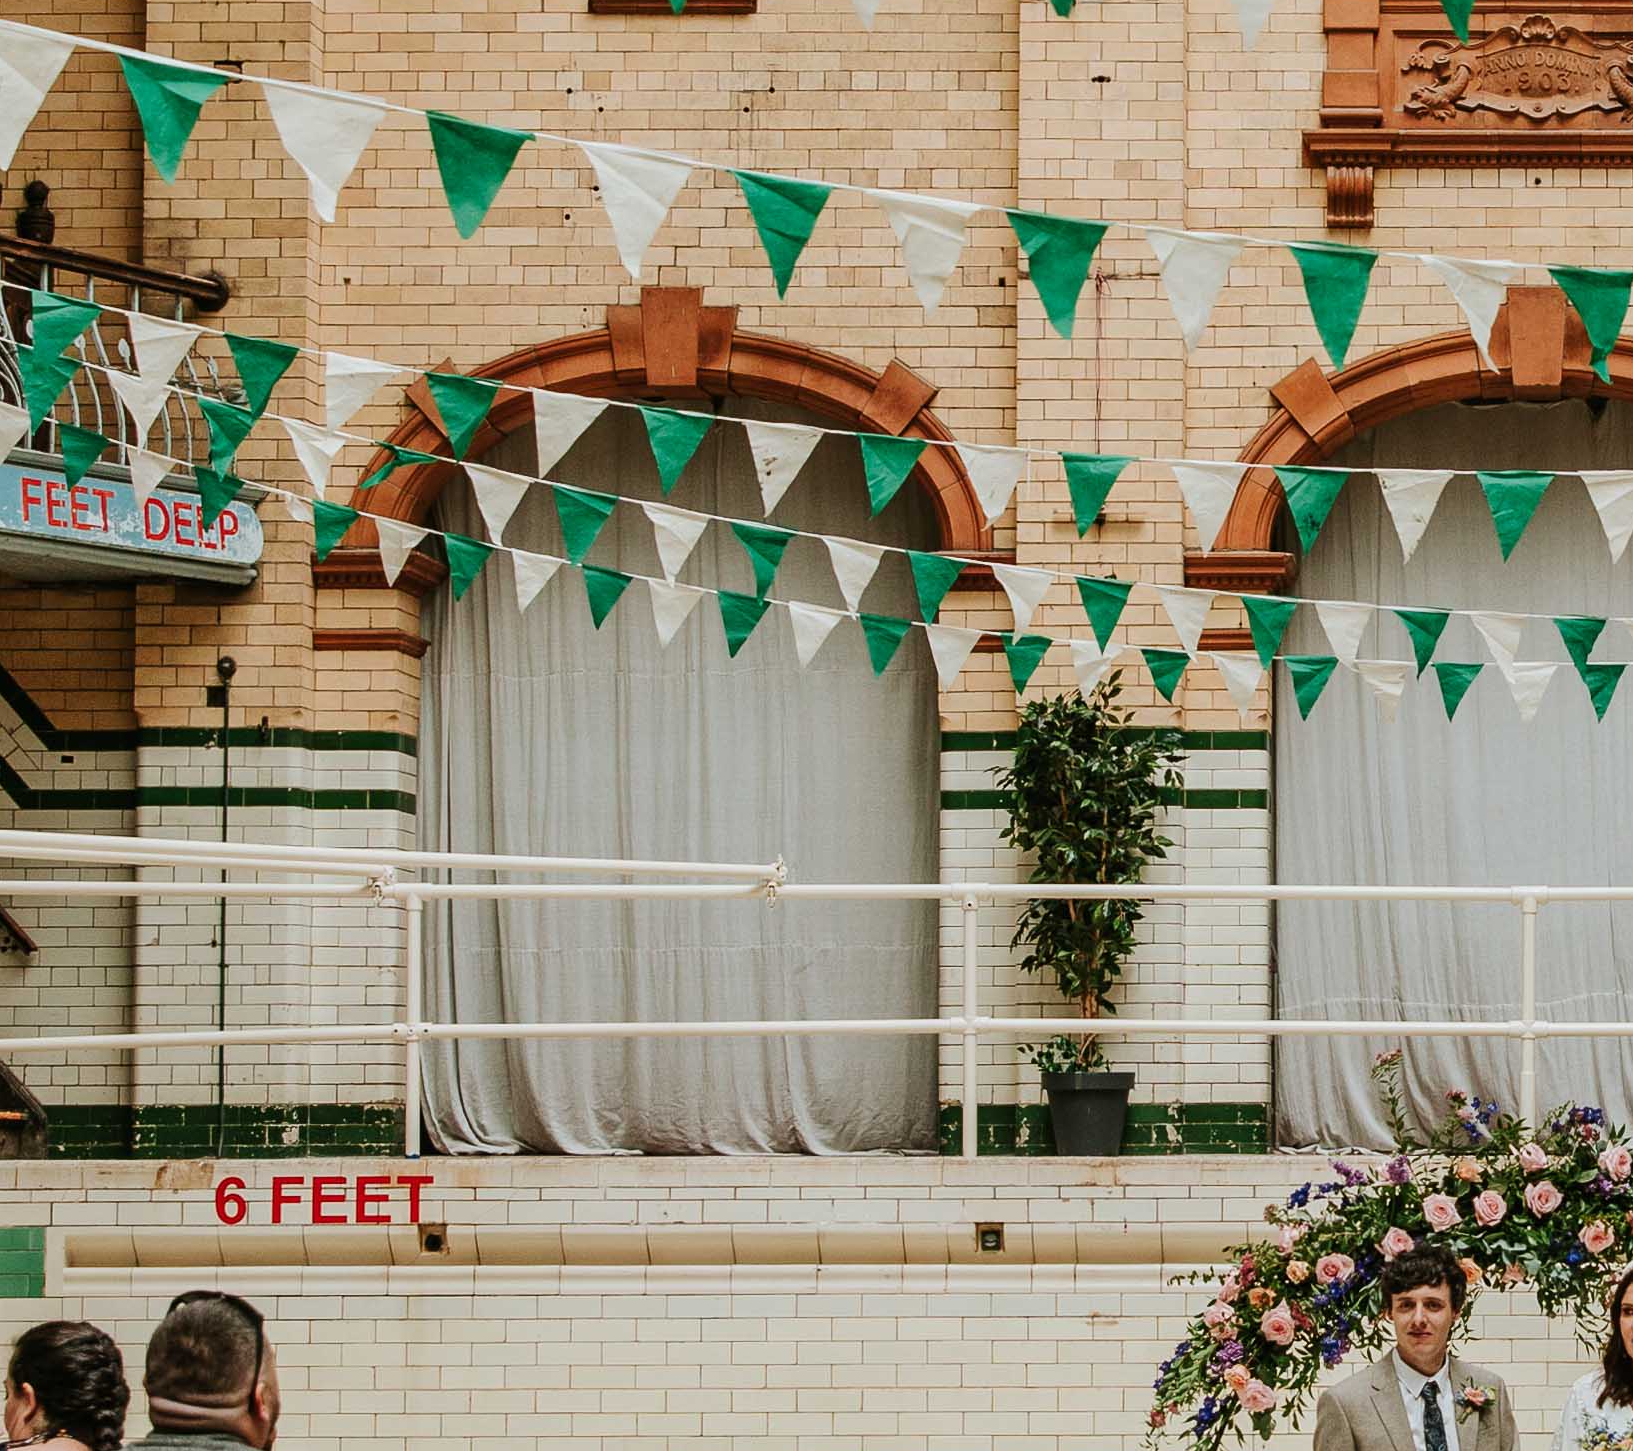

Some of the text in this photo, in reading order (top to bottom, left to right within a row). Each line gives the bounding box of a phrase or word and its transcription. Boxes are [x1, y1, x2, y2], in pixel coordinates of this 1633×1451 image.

[20, 477, 115, 532] FEET
[215, 1175, 435, 1226] 6 FEET
